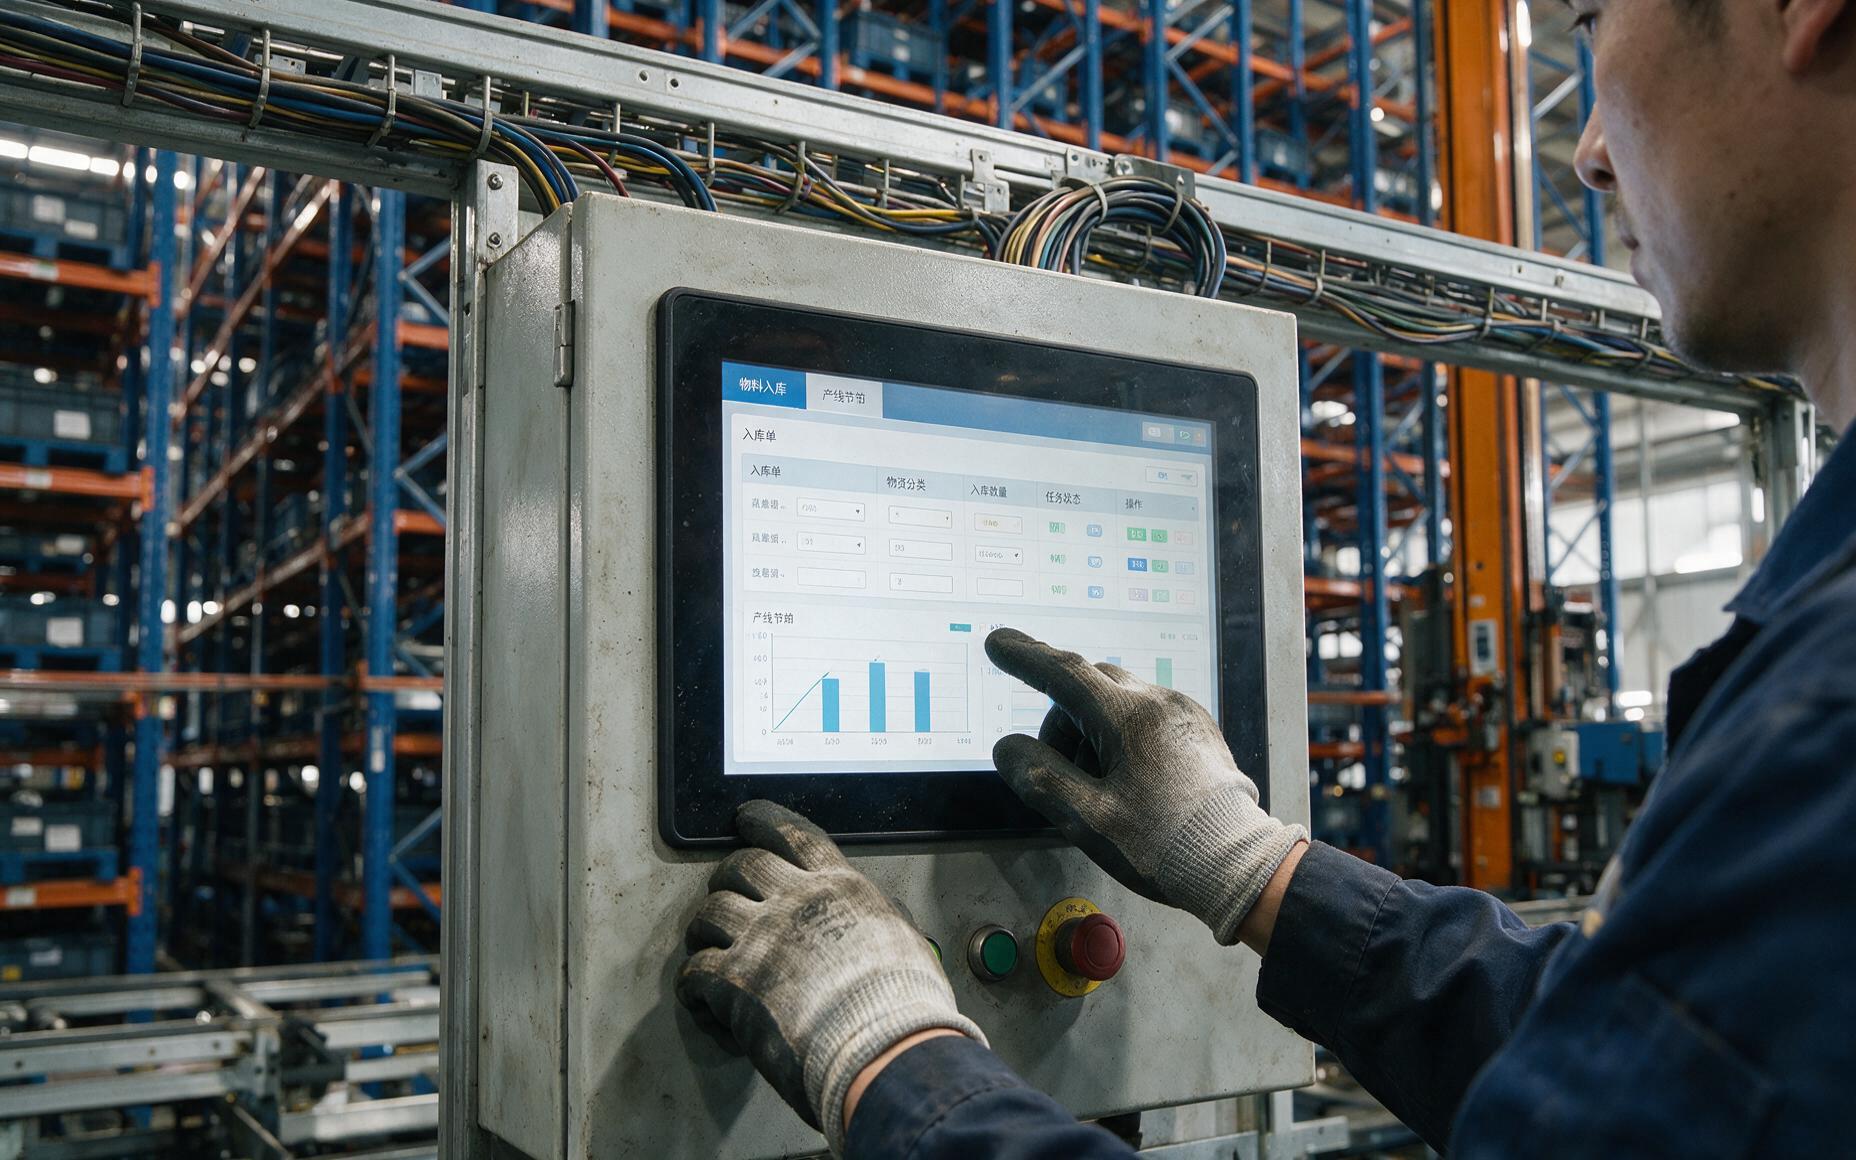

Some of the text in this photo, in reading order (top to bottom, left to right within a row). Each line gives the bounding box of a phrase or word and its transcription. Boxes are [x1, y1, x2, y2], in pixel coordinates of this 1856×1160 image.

[739, 377, 787, 396] 物料入库
[742, 427, 776, 442] 入库单
[750, 464, 781, 478] 入库单
[886, 476, 926, 491] 物资分类
